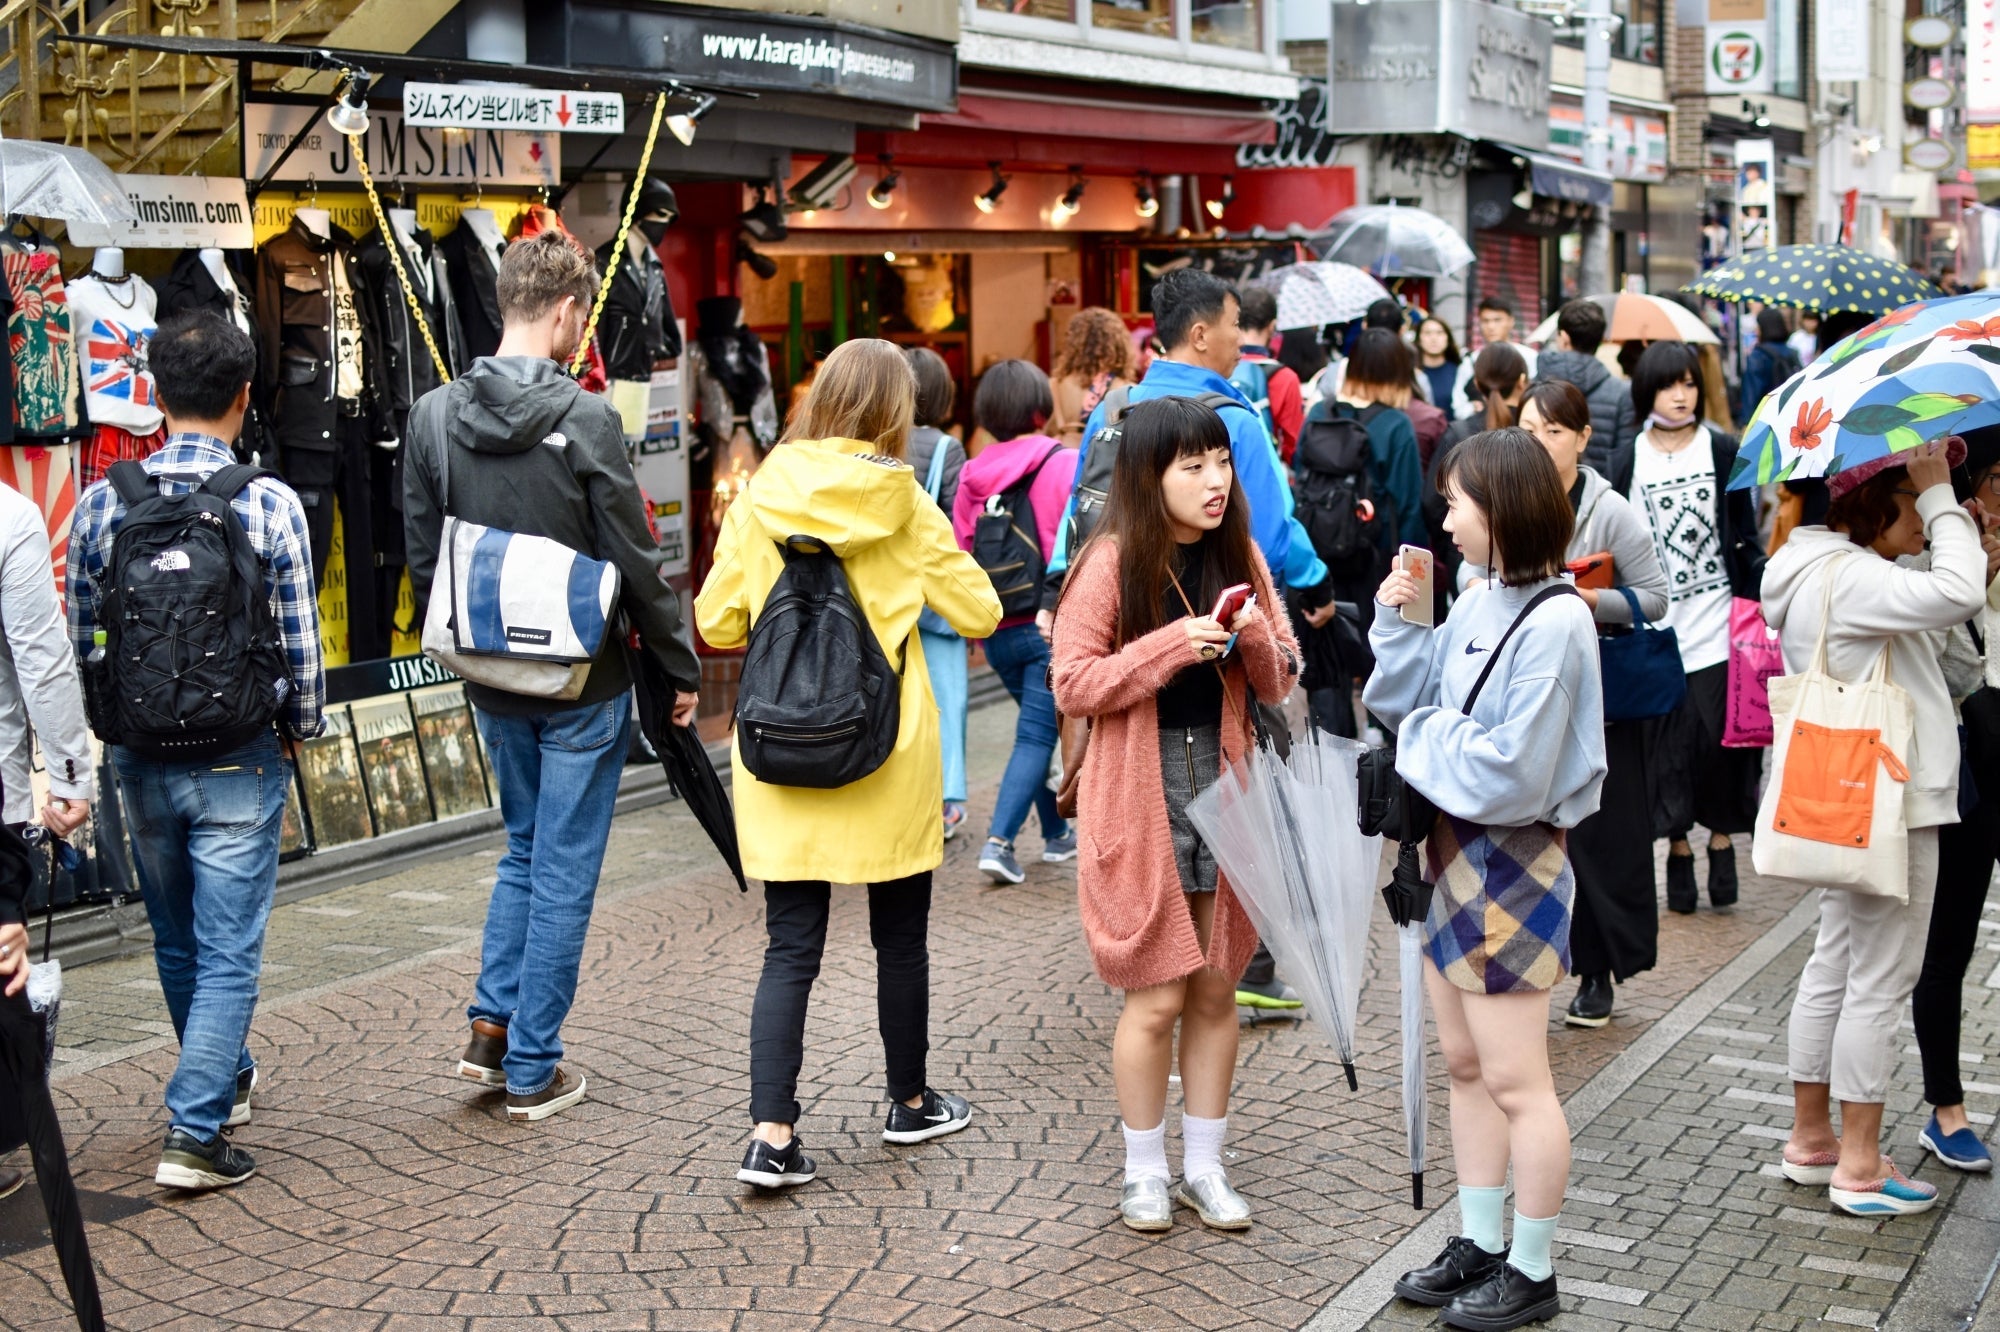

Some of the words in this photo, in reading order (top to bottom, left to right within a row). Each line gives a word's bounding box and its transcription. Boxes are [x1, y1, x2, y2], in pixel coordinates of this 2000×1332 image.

[575, 100, 619, 126] 営業中
[257, 133, 286, 150] TOKYO
[161, 551, 176, 559] THE
[151, 559, 175, 568] NORTH
[510, 632, 545, 640] FREITAG
[361, 715, 410, 742] JIMSIN
